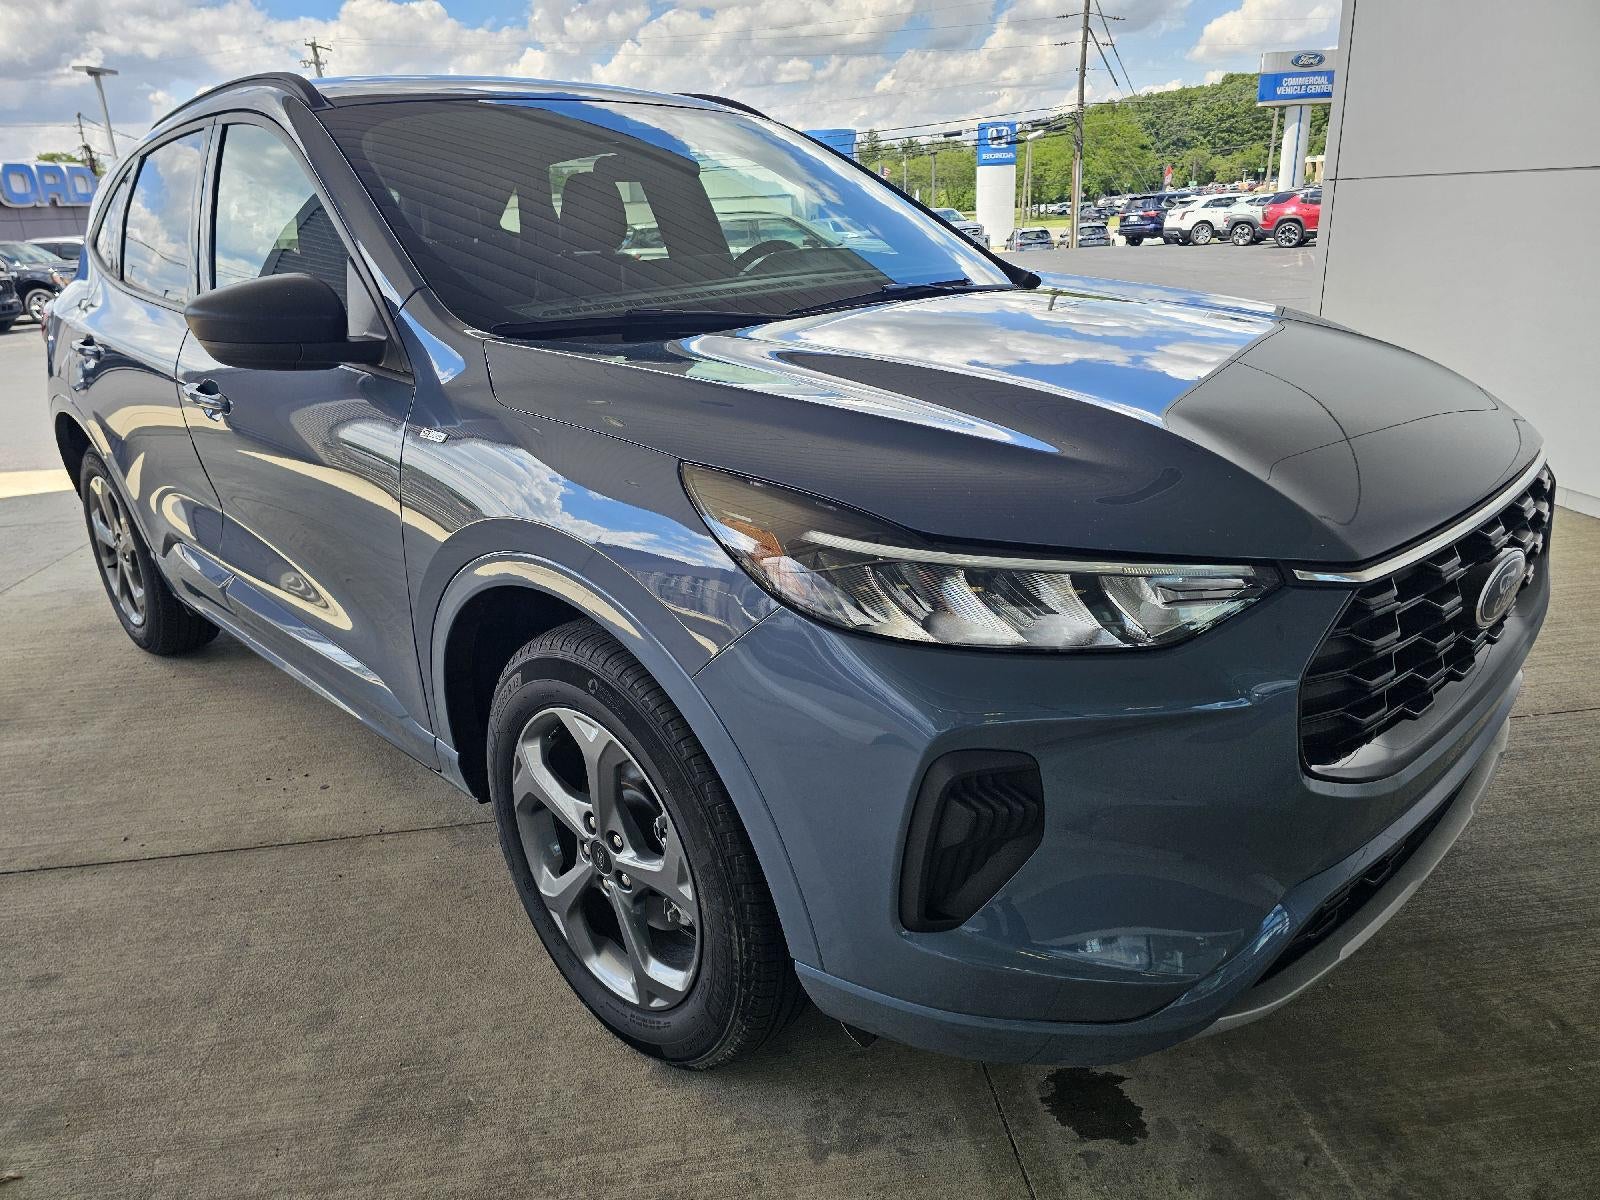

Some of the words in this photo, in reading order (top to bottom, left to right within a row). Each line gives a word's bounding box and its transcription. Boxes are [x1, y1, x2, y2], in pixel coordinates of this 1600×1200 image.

[1282, 75, 1329, 86] COMMERCIAL
[1276, 85, 1306, 95] VEHICLE
[1306, 84, 1333, 93] CENTER
[982, 152, 1014, 160] HONDA
